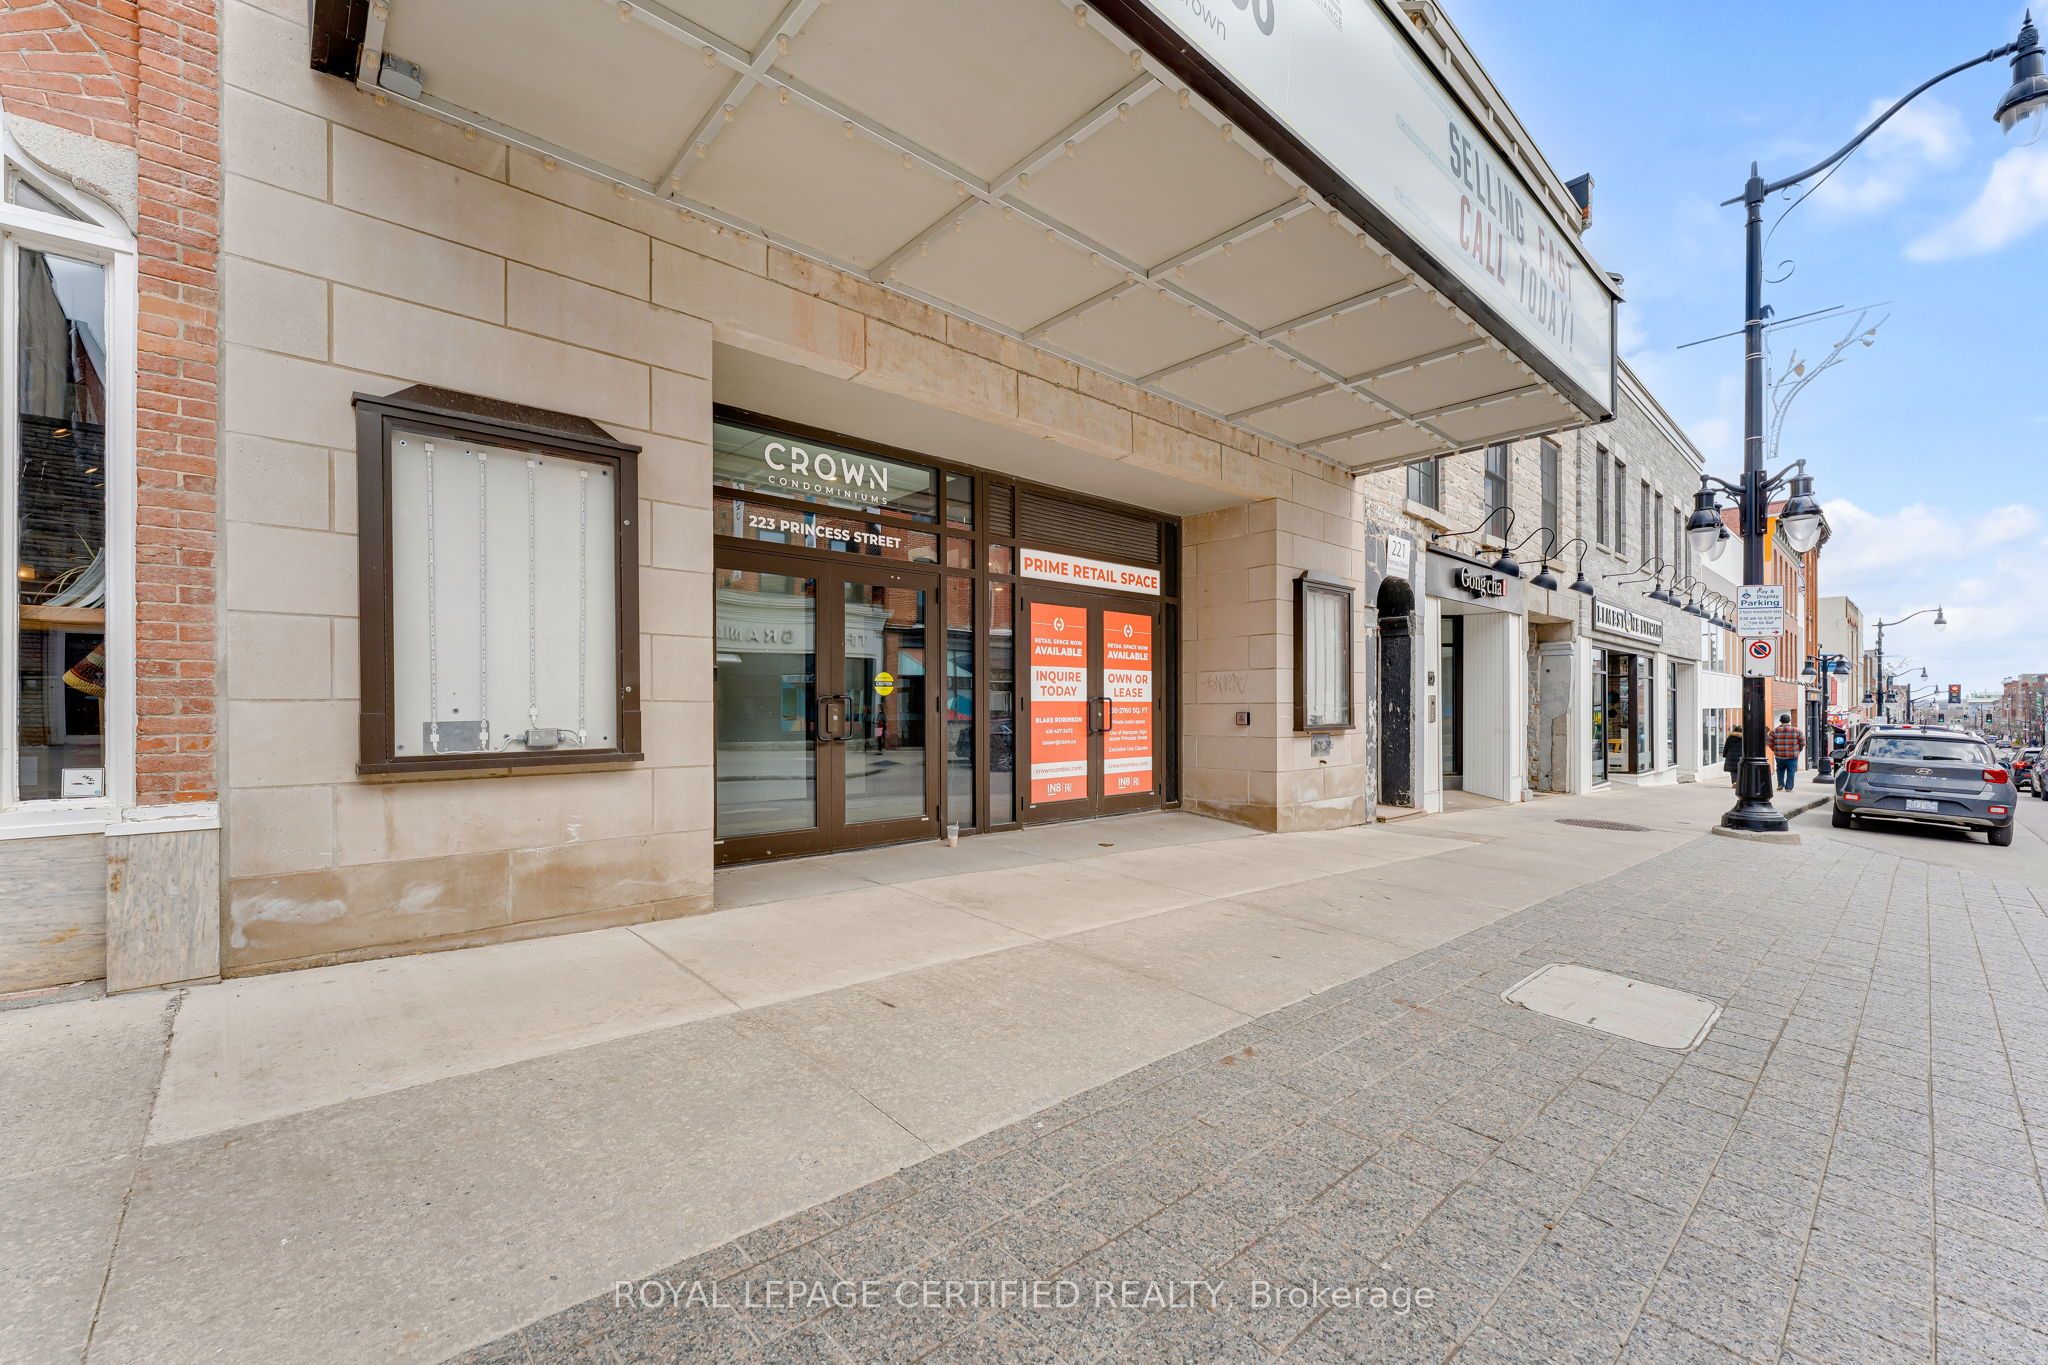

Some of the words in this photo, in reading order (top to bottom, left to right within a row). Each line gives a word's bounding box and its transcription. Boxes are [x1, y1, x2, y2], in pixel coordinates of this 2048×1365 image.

[1449, 121, 1525, 247] SELLING
[1537, 224, 1573, 302] FAST
[1459, 193, 1505, 287] CALL
[1519, 254, 1575, 353] TODAY!
[765, 442, 888, 492] CROWN
[768, 475, 888, 505] CONDOMINIUMS
[749, 515, 776, 530] 223
[780, 519, 851, 541] PRINCESS
[853, 532, 901, 549] STREET
[1391, 540, 1406, 559] 221
[1024, 557, 1069, 576] PRIME
[1073, 564, 1117, 583] RETAIL
[1120, 572, 1157, 589] SPACE
[1597, 605, 1639, 632] LIMESTONE
[1035, 646, 1082, 656] AVAILABLE
[1107, 651, 1148, 661] AVAILABLE
[1036, 670, 1082, 683] INQUIRE
[1107, 673, 1132, 684] OWN
[1134, 674, 1148, 684] OR
[1040, 685, 1077, 697] TODAY
[1113, 687, 1143, 698] LEASE
[1035, 765, 1082, 774] crowncondos.com
[1108, 761, 1149, 769] crowncondos.com
[1047, 782, 1061, 793] IN8
